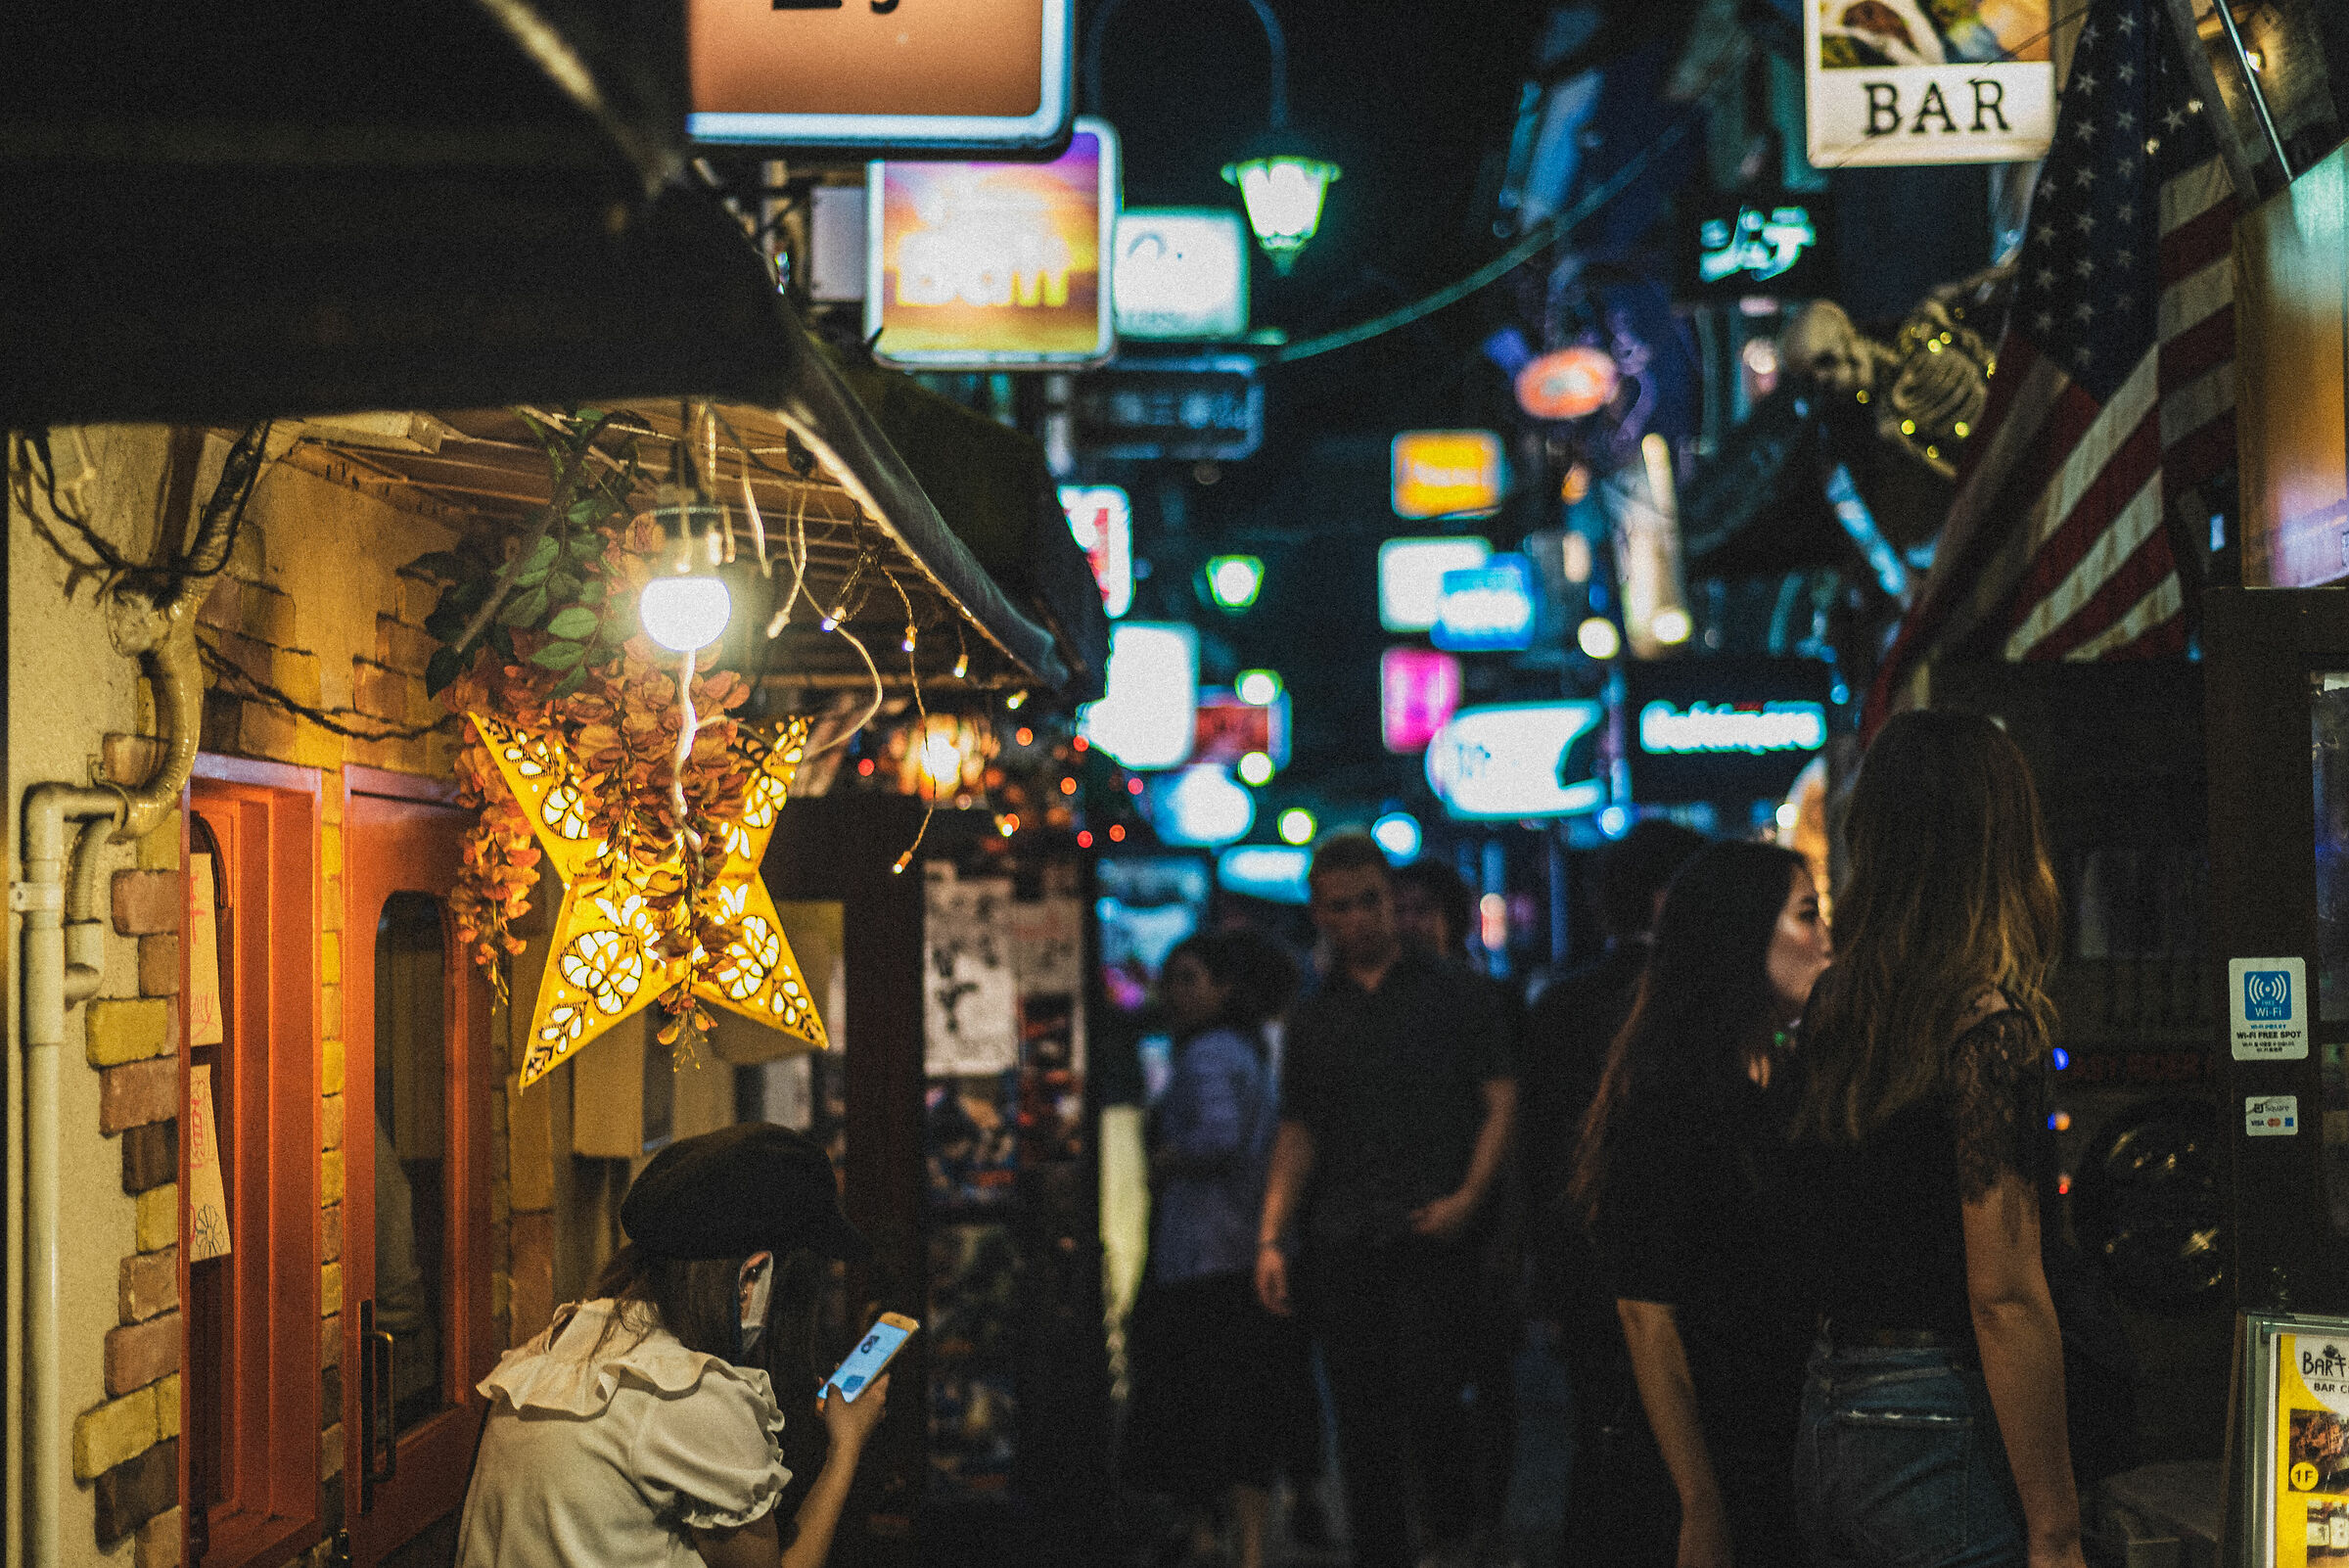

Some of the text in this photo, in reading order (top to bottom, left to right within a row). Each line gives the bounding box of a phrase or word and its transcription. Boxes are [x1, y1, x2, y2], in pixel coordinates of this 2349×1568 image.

[1863, 78, 2010, 136] BAR
[2255, 1006, 2281, 1017] Wi-Fi
[2314, 1383, 2349, 1394] BAR C
[2295, 1469, 2313, 1483] 1F
